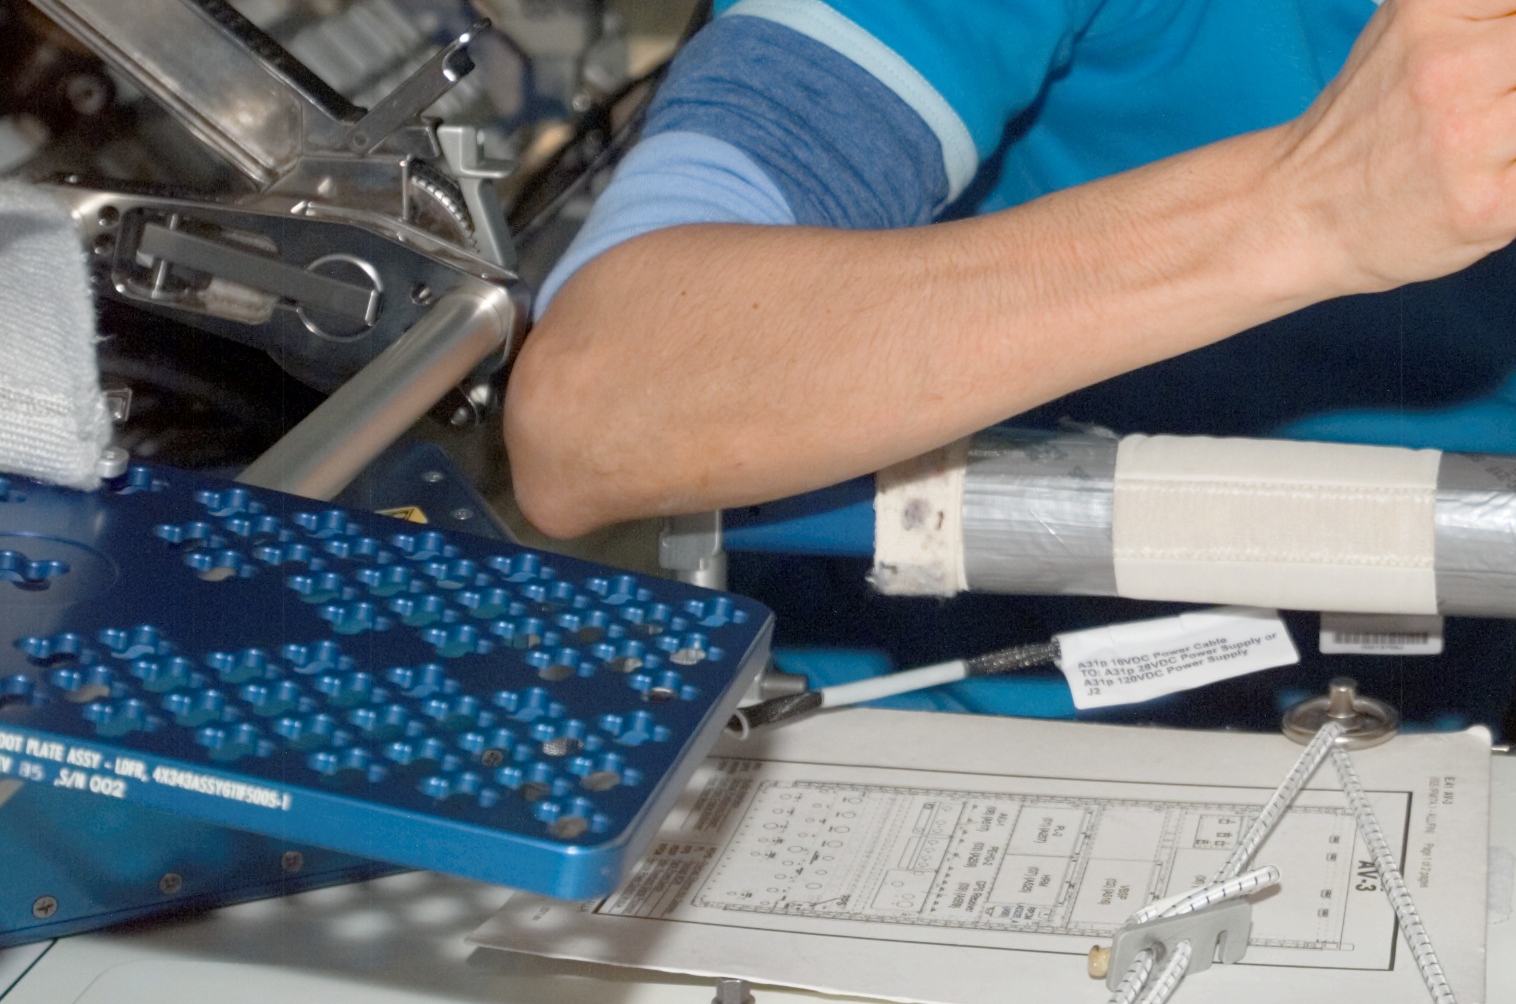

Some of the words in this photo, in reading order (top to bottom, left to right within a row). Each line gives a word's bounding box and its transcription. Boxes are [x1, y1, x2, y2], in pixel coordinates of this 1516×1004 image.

[1077, 659, 1107, 671] A31p
[1152, 645, 1190, 659] Power
[1193, 636, 1228, 651] Cable
[1080, 669, 1101, 678] TO:
[1104, 665, 1136, 678] A31p
[1138, 656, 1178, 673] 28VDC
[1180, 647, 1218, 662] Power
[1221, 637, 1262, 653] Supply
[1264, 632, 1278, 642] or
[1084, 676, 1115, 688] A31p
[1118, 667, 1164, 685] 120VDC
[1167, 659, 1205, 675] Power
[1207, 649, 1249, 665] Supply
[1087, 687, 1102, 696] J2
[25, 736, 65, 764] PLATE
[67, 746, 103, 770] ASSY
[89, 776, 129, 799] 002
[1420, 843, 1434, 857] Page
[1354, 859, 1379, 892] AV-3
[1117, 885, 1131, 900] VBSP
